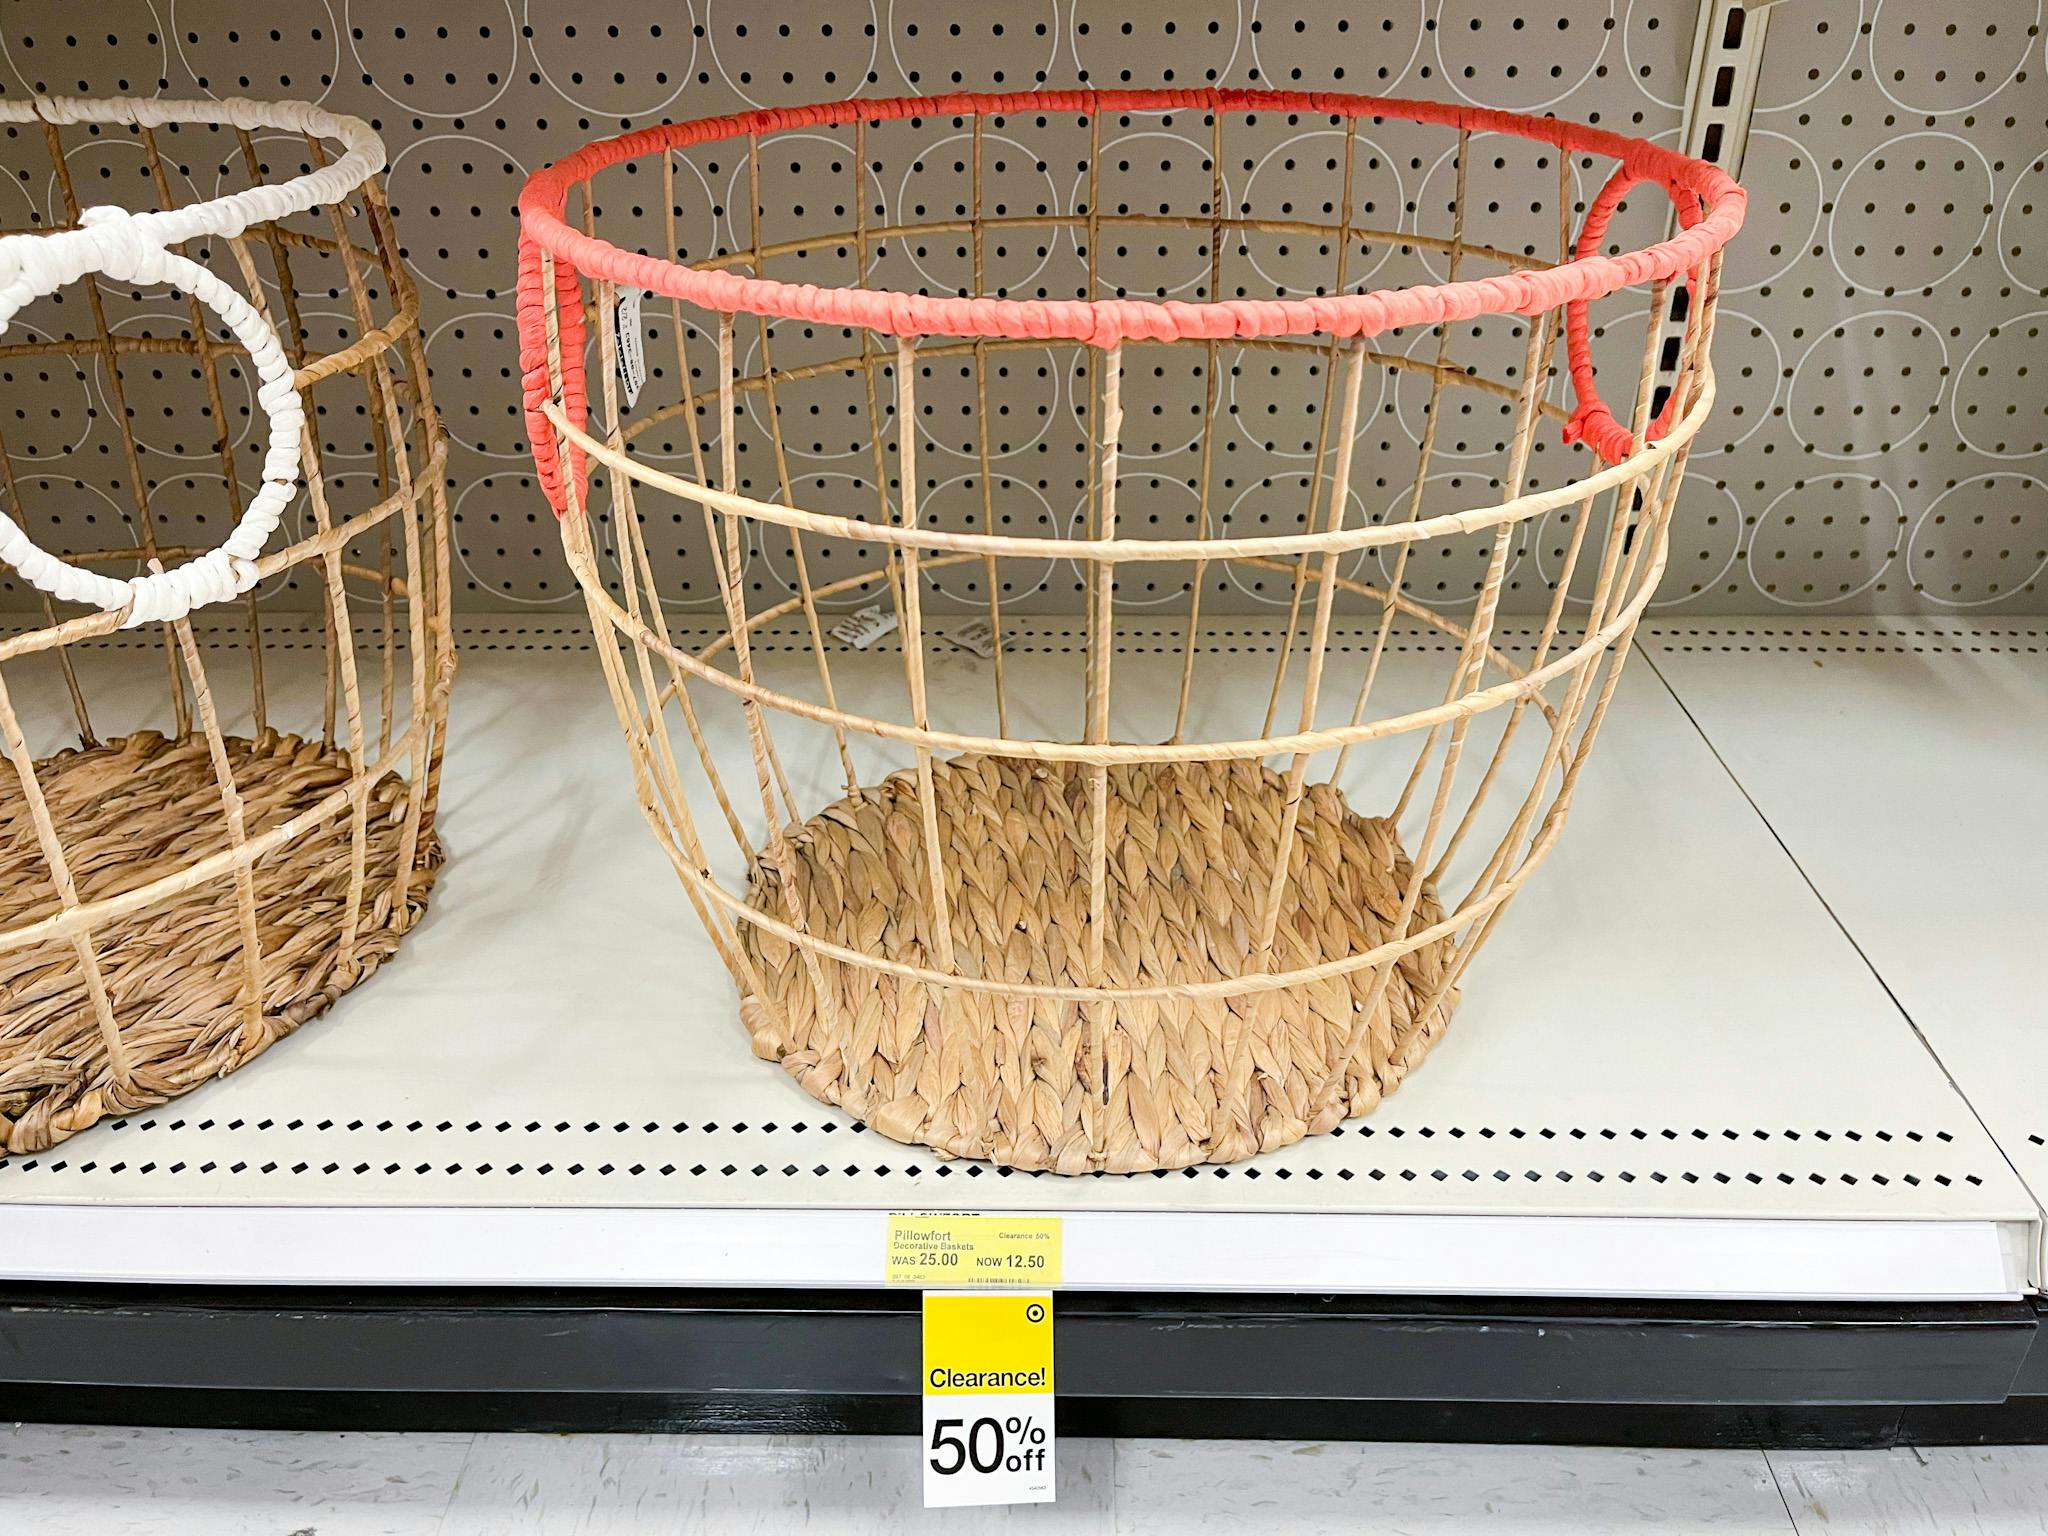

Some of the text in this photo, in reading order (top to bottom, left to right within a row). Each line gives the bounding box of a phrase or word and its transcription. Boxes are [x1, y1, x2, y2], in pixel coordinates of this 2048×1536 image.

[894, 1230, 951, 1241] Pillowfort
[998, 1232, 1033, 1240] Clearance
[894, 1242, 974, 1251] Decorative Baskets
[892, 1253, 958, 1266] WAS 25.00
[976, 1254, 1045, 1268] NOW 12.50
[929, 1367, 1046, 1388] Clearance!
[929, 1416, 1046, 1475] 50%
[1005, 1448, 1046, 1472] off
